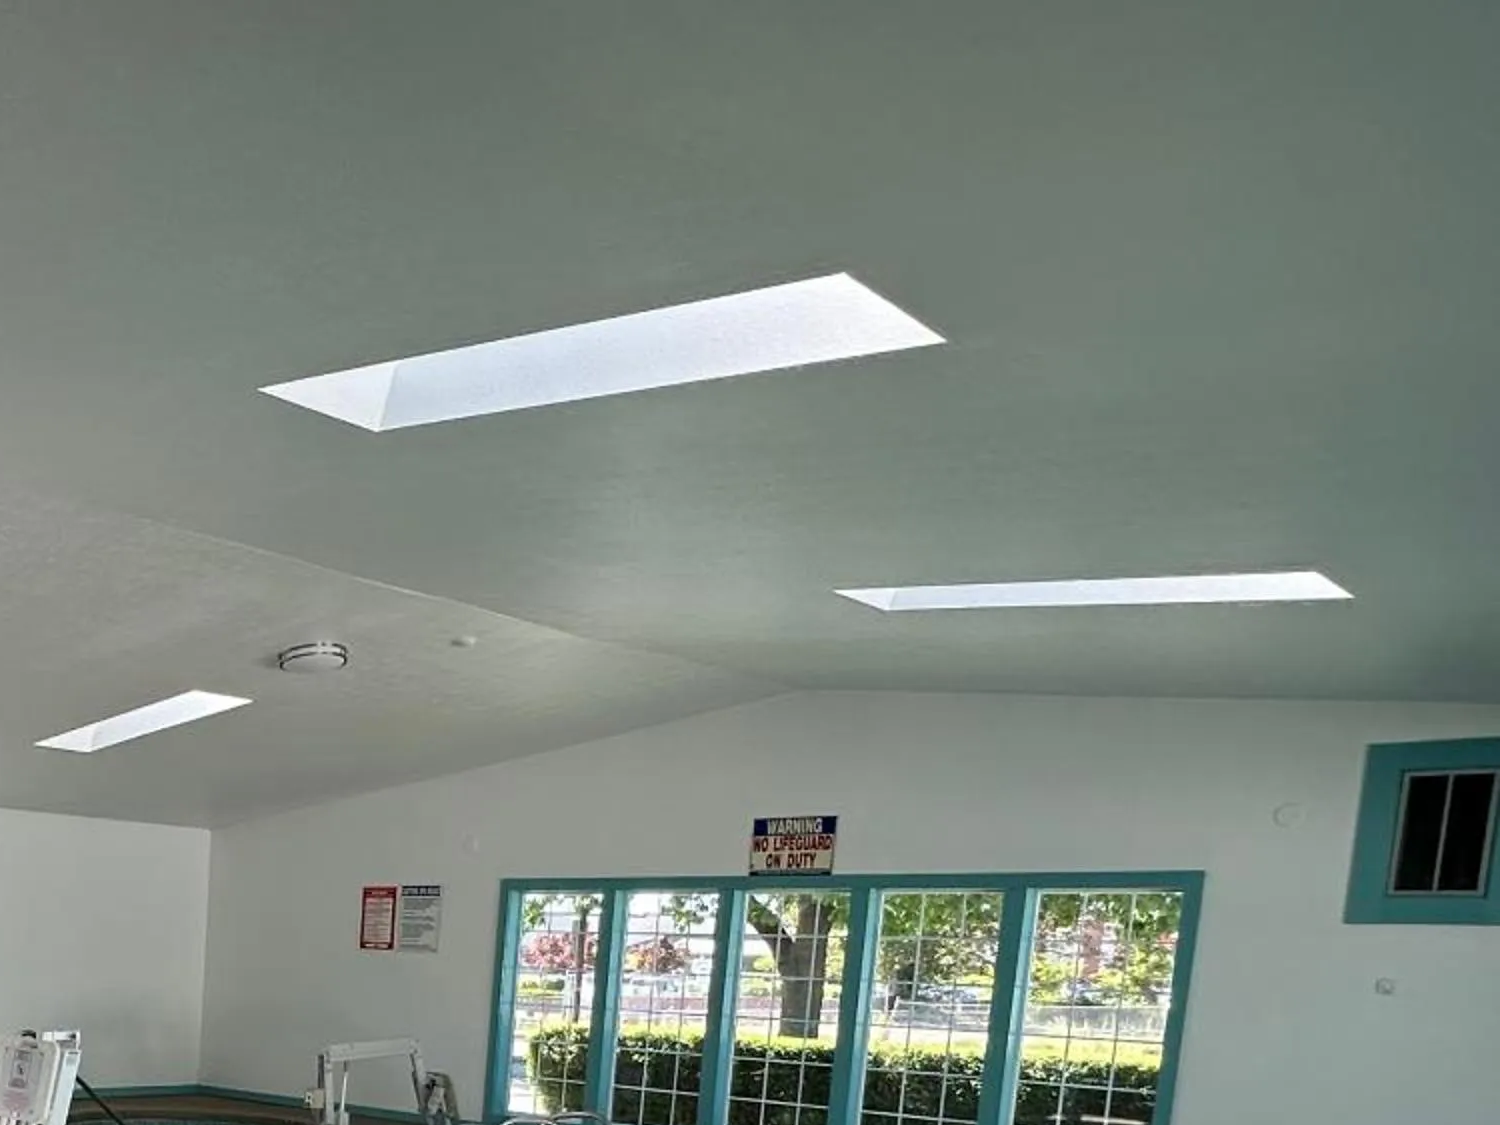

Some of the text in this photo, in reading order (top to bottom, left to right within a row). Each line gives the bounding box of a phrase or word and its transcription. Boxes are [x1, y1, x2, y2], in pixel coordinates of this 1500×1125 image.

[767, 817, 823, 835] WARNING
[753, 835, 832, 852] NO LIFEGUARD
[765, 852, 817, 868] ON DUTY
